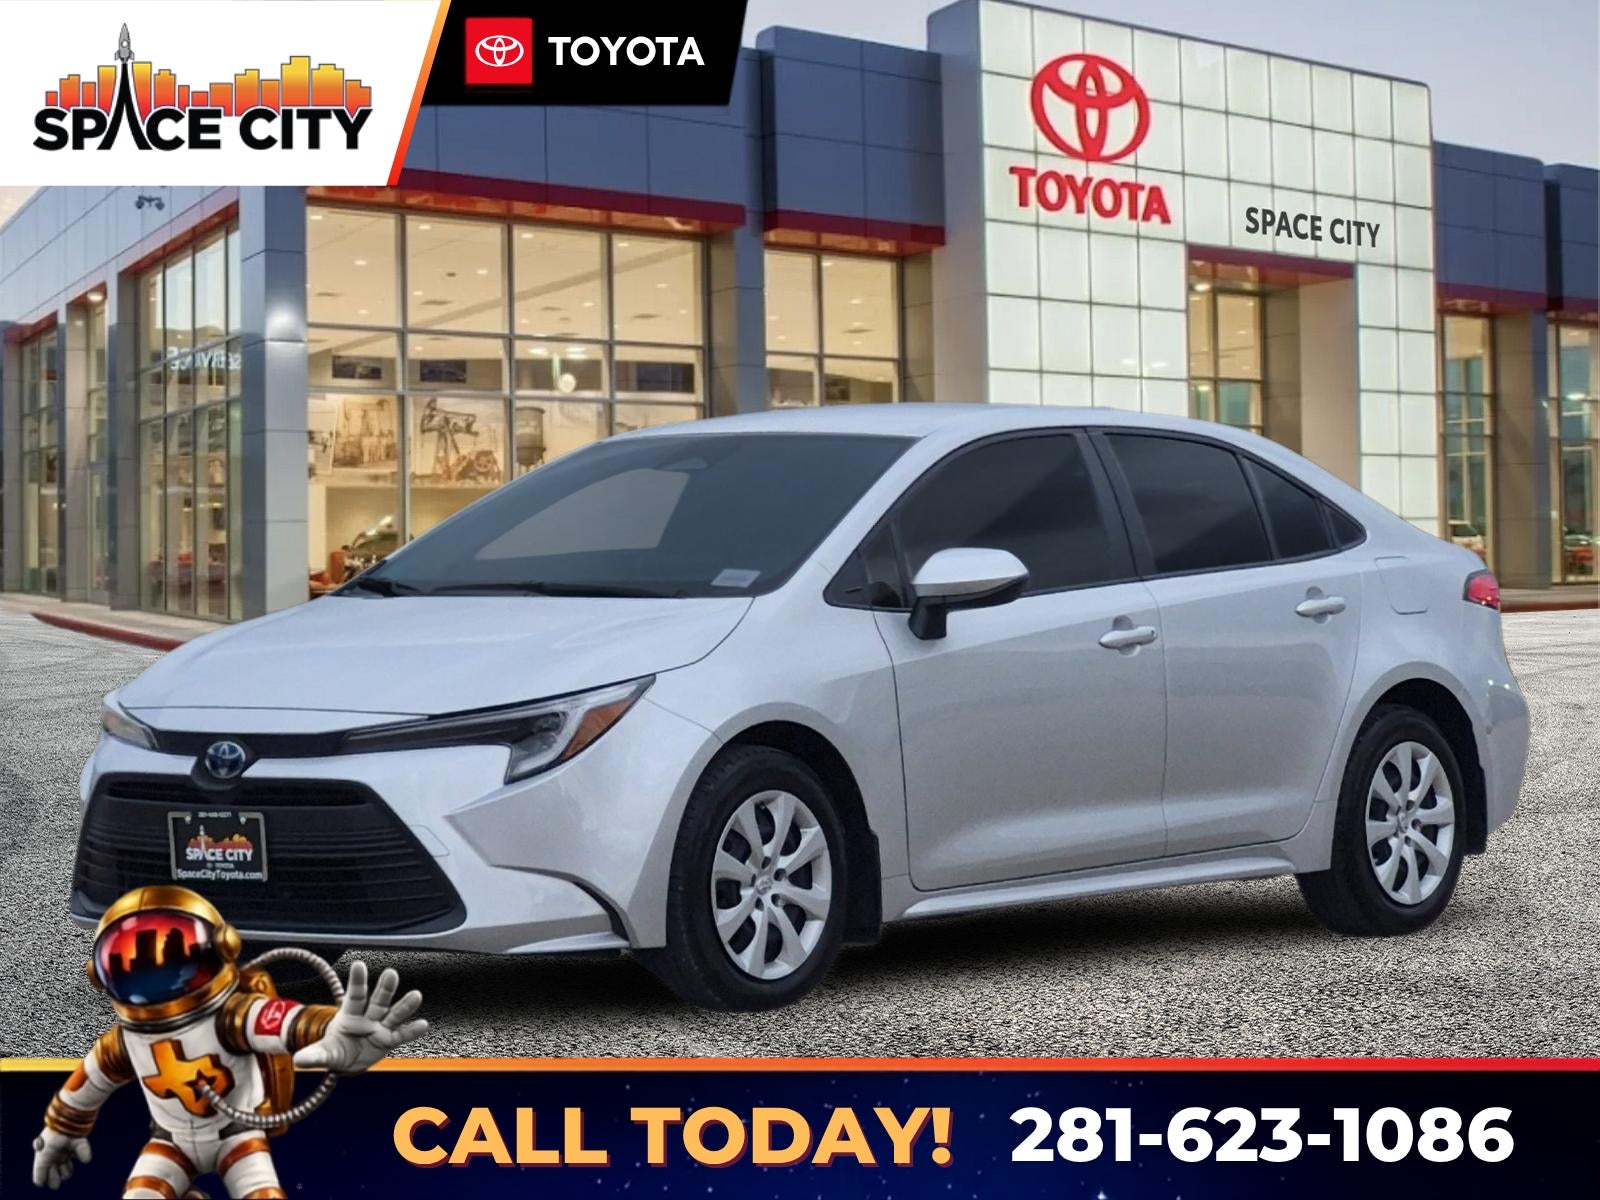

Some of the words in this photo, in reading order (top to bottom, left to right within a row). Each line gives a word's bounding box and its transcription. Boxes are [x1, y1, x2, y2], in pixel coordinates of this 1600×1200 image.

[1009, 166, 1171, 225] TOYOTA
[1245, 206, 1322, 242] SPACE
[1329, 217, 1380, 248] CITY
[186, 847, 224, 861] SPACE
[225, 848, 253, 861] CITY
[177, 868, 263, 880] SpaceCityToyota.com
